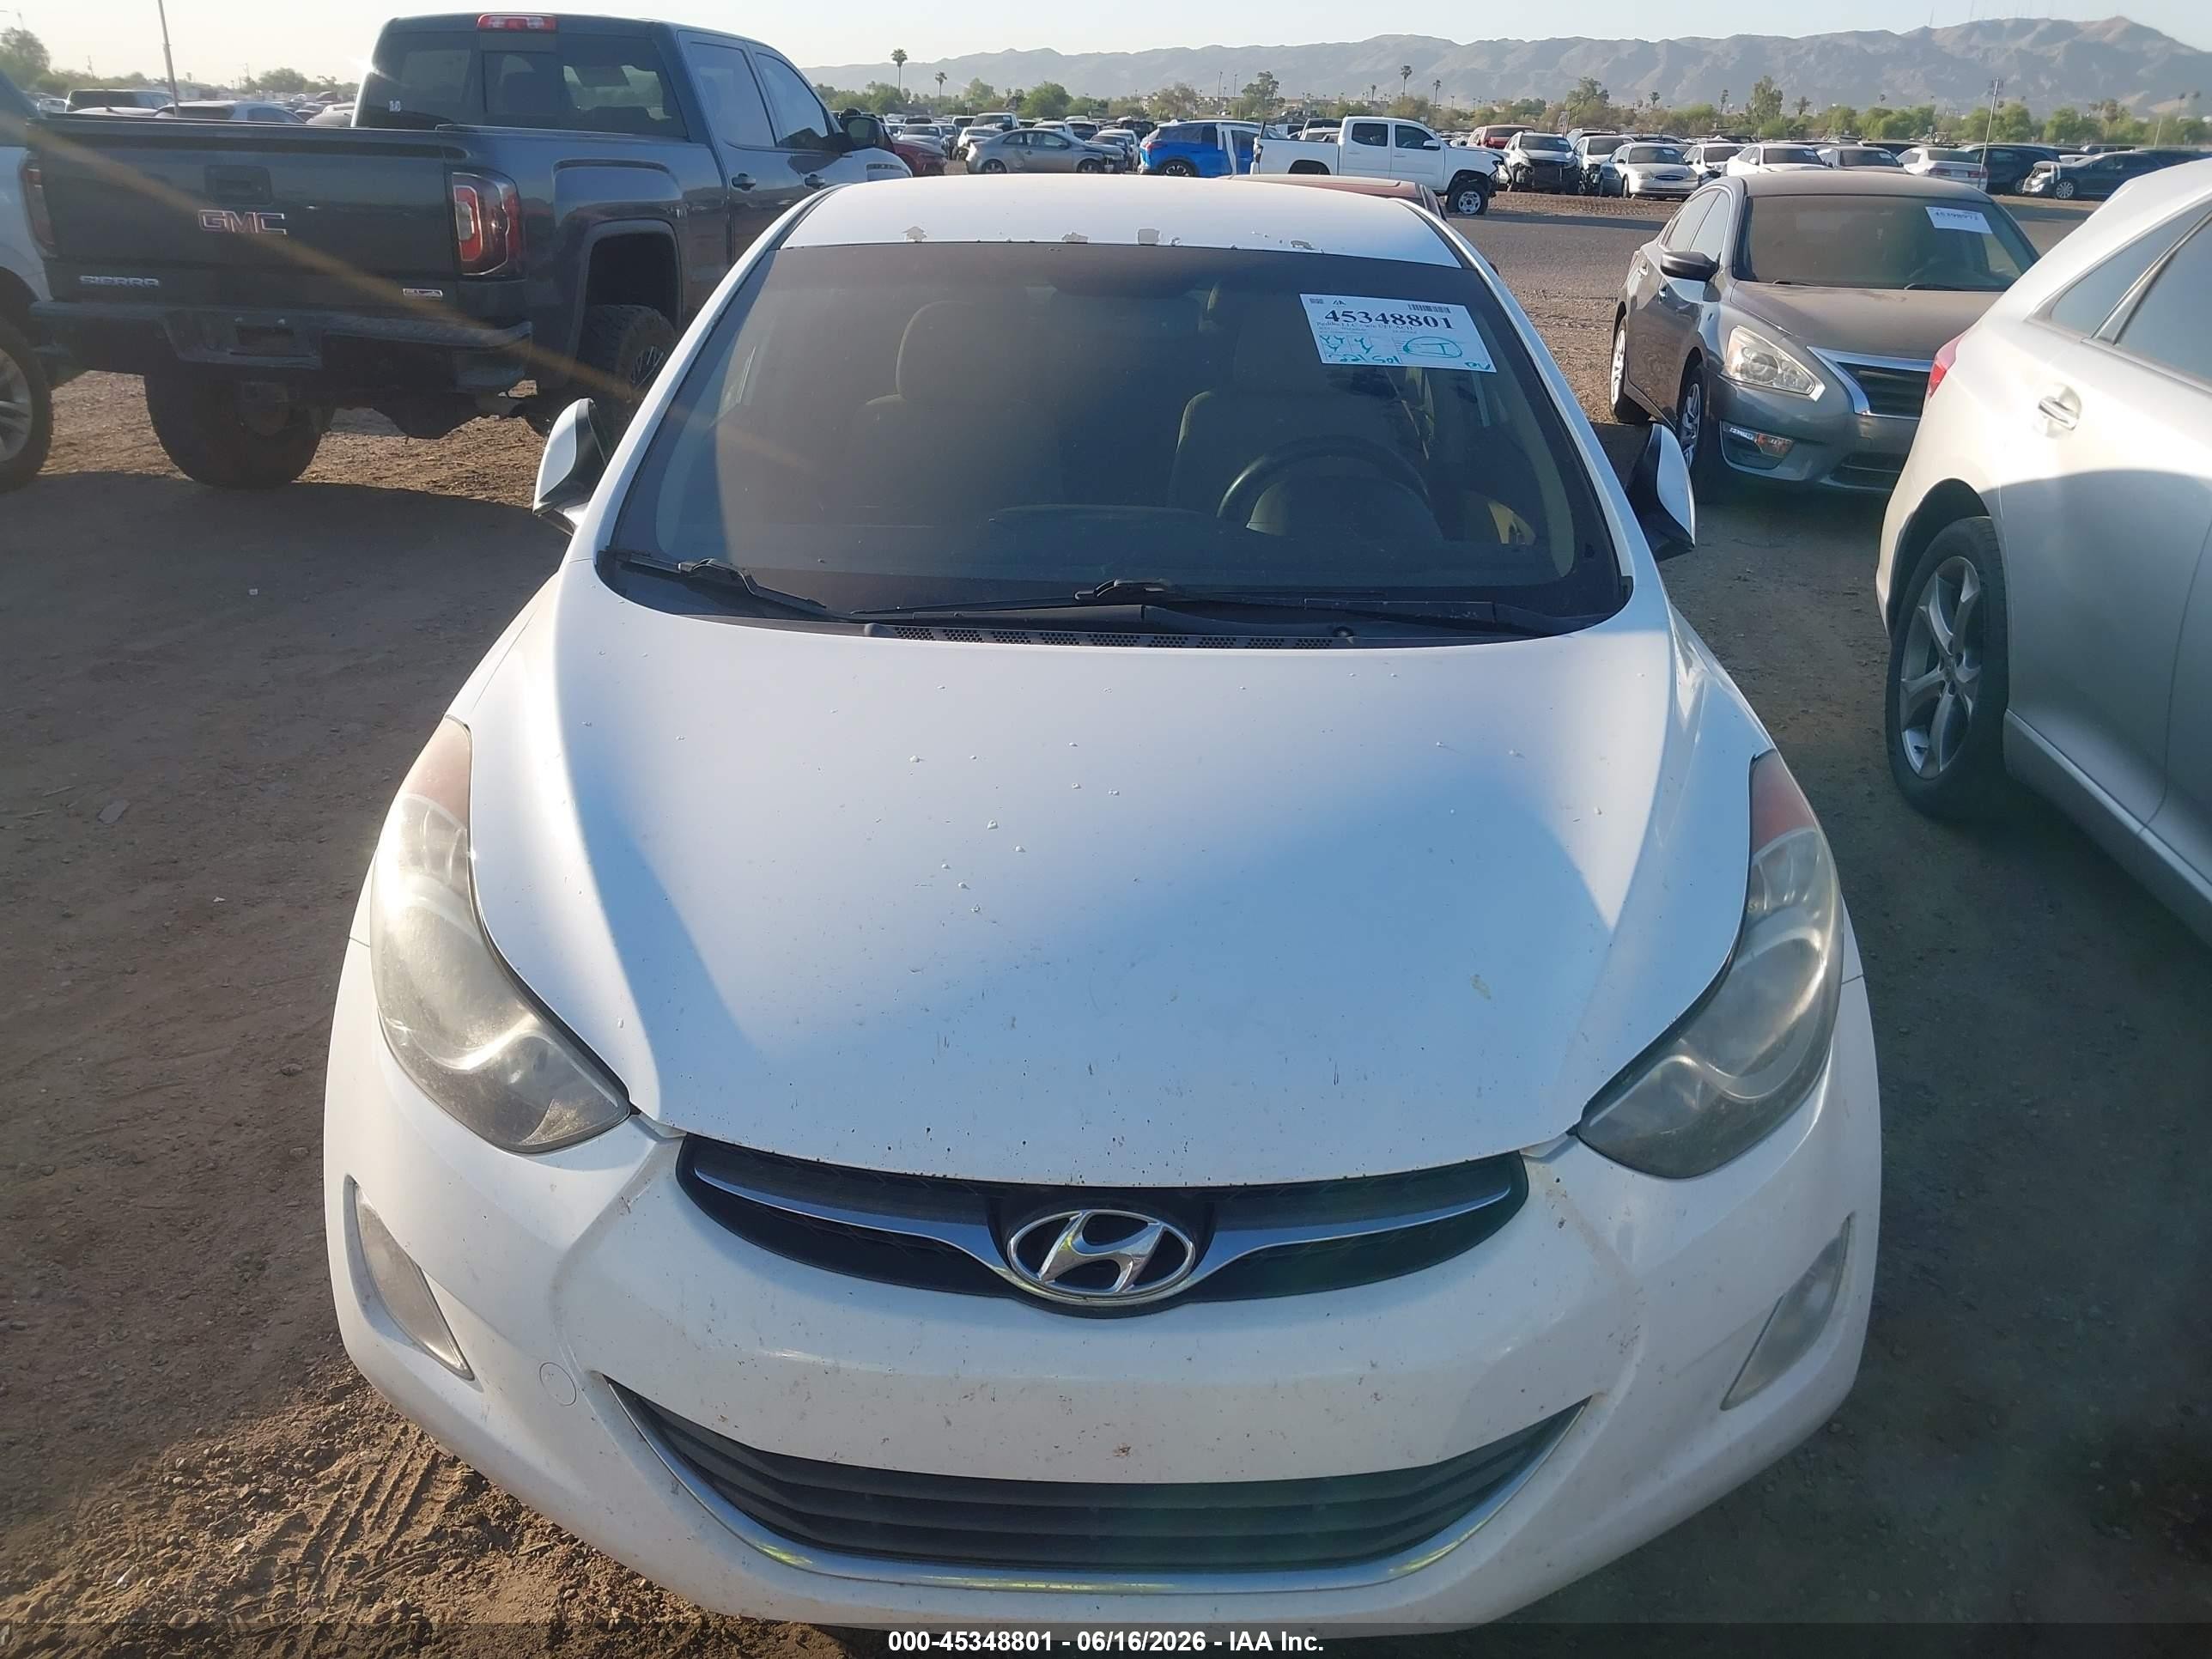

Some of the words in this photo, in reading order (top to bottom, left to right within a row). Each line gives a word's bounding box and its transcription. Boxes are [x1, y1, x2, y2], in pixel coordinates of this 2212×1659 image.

[198, 210, 287, 234] GMC
[80, 276, 159, 287] SIERRA
[1325, 309, 1455, 330] 45348801
